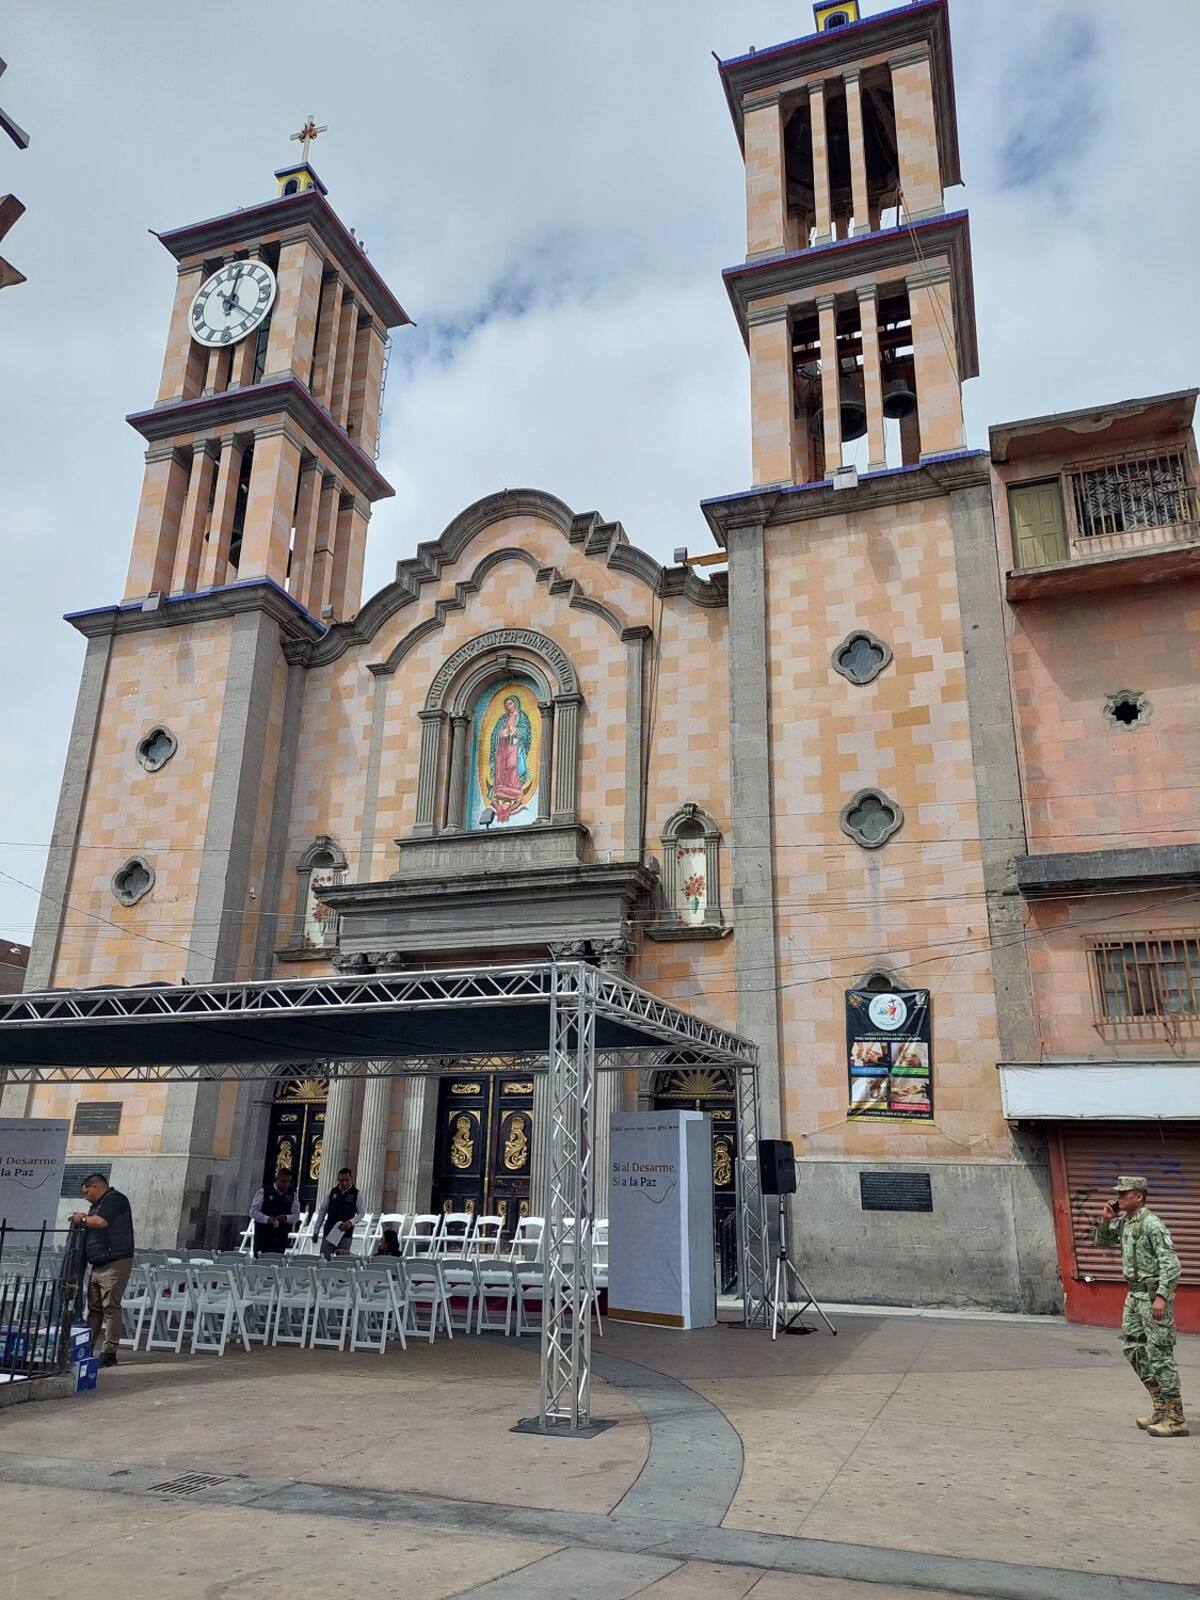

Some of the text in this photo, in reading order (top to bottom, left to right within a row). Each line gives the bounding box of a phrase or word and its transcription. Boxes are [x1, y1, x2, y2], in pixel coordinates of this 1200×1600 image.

[227, 261, 244, 281] 12
[259, 284, 271, 302] 3
[193, 303, 204, 321] 9
[221, 325, 232, 344] 6
[6, 1157, 59, 1165] Desarme,
[621, 1162, 629, 1172] al
[1, 1168, 34, 1176] la Paz
[629, 1177, 638, 1186] la
[640, 1177, 657, 1187] Paz
